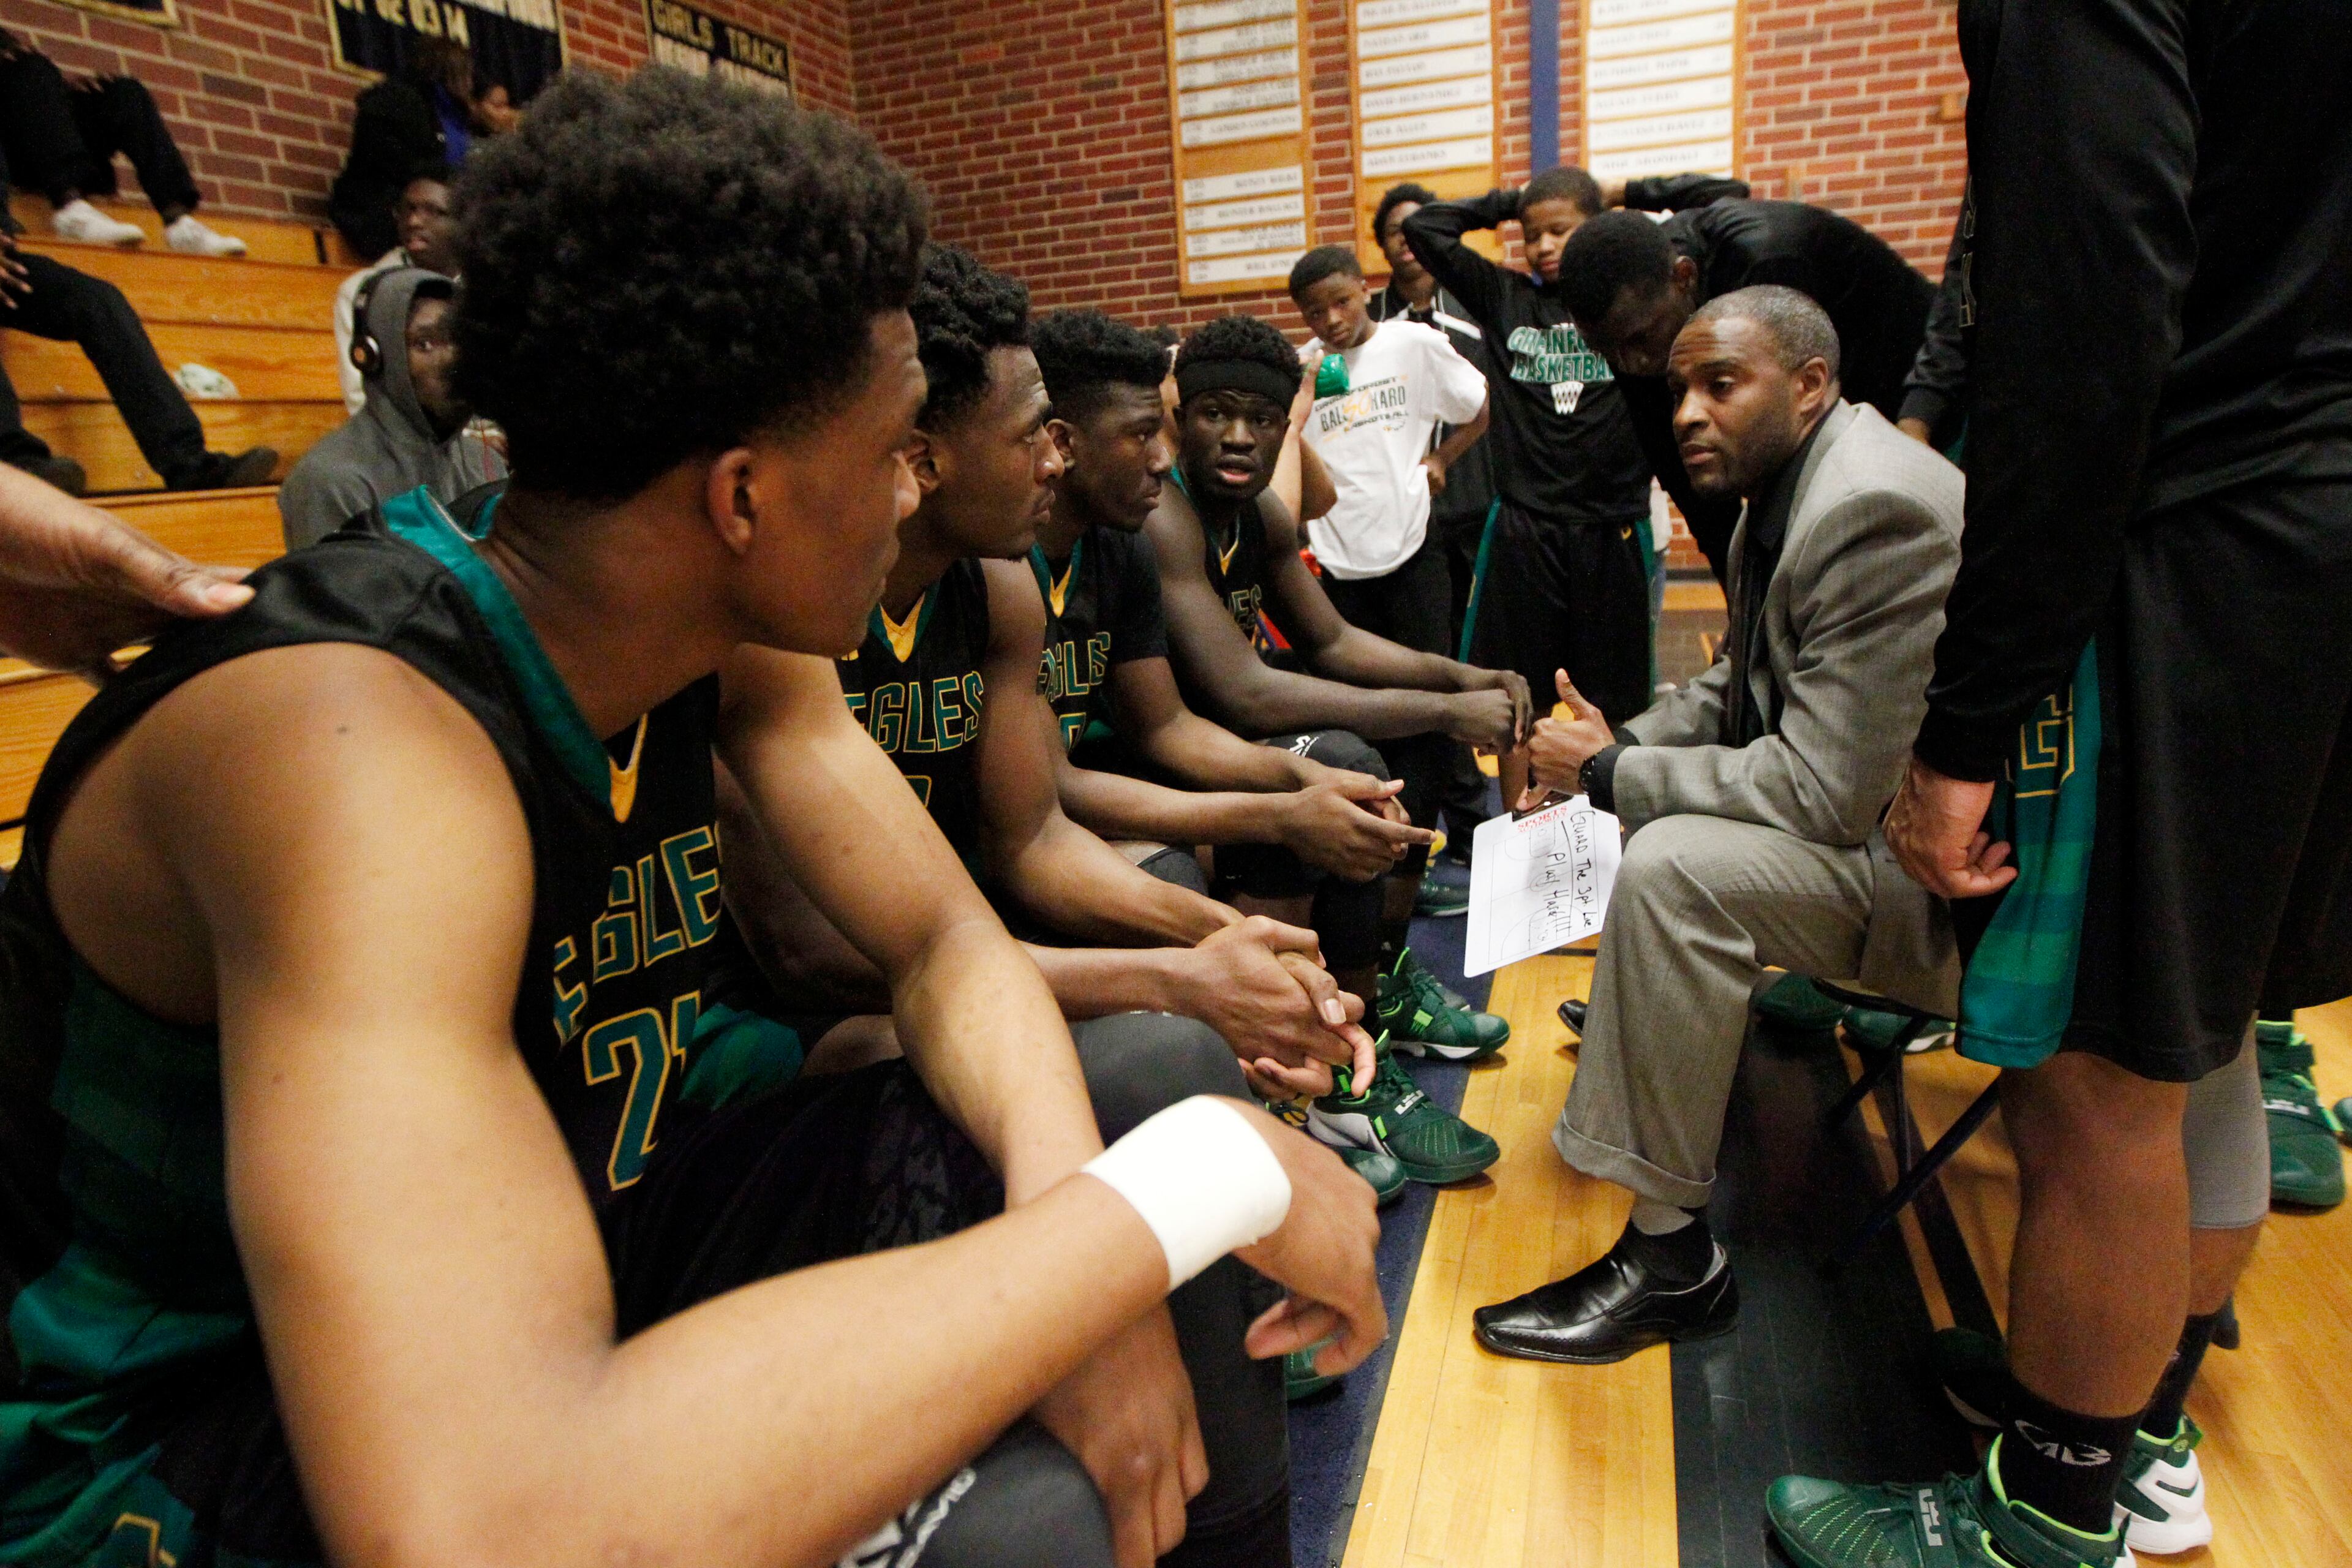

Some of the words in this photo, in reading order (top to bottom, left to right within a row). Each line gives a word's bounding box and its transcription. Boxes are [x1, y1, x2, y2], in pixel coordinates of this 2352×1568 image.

[651, 0, 715, 51] GIRLS
[724, 26, 788, 78] TRACK
[1518, 805, 1567, 831] SPORTS
